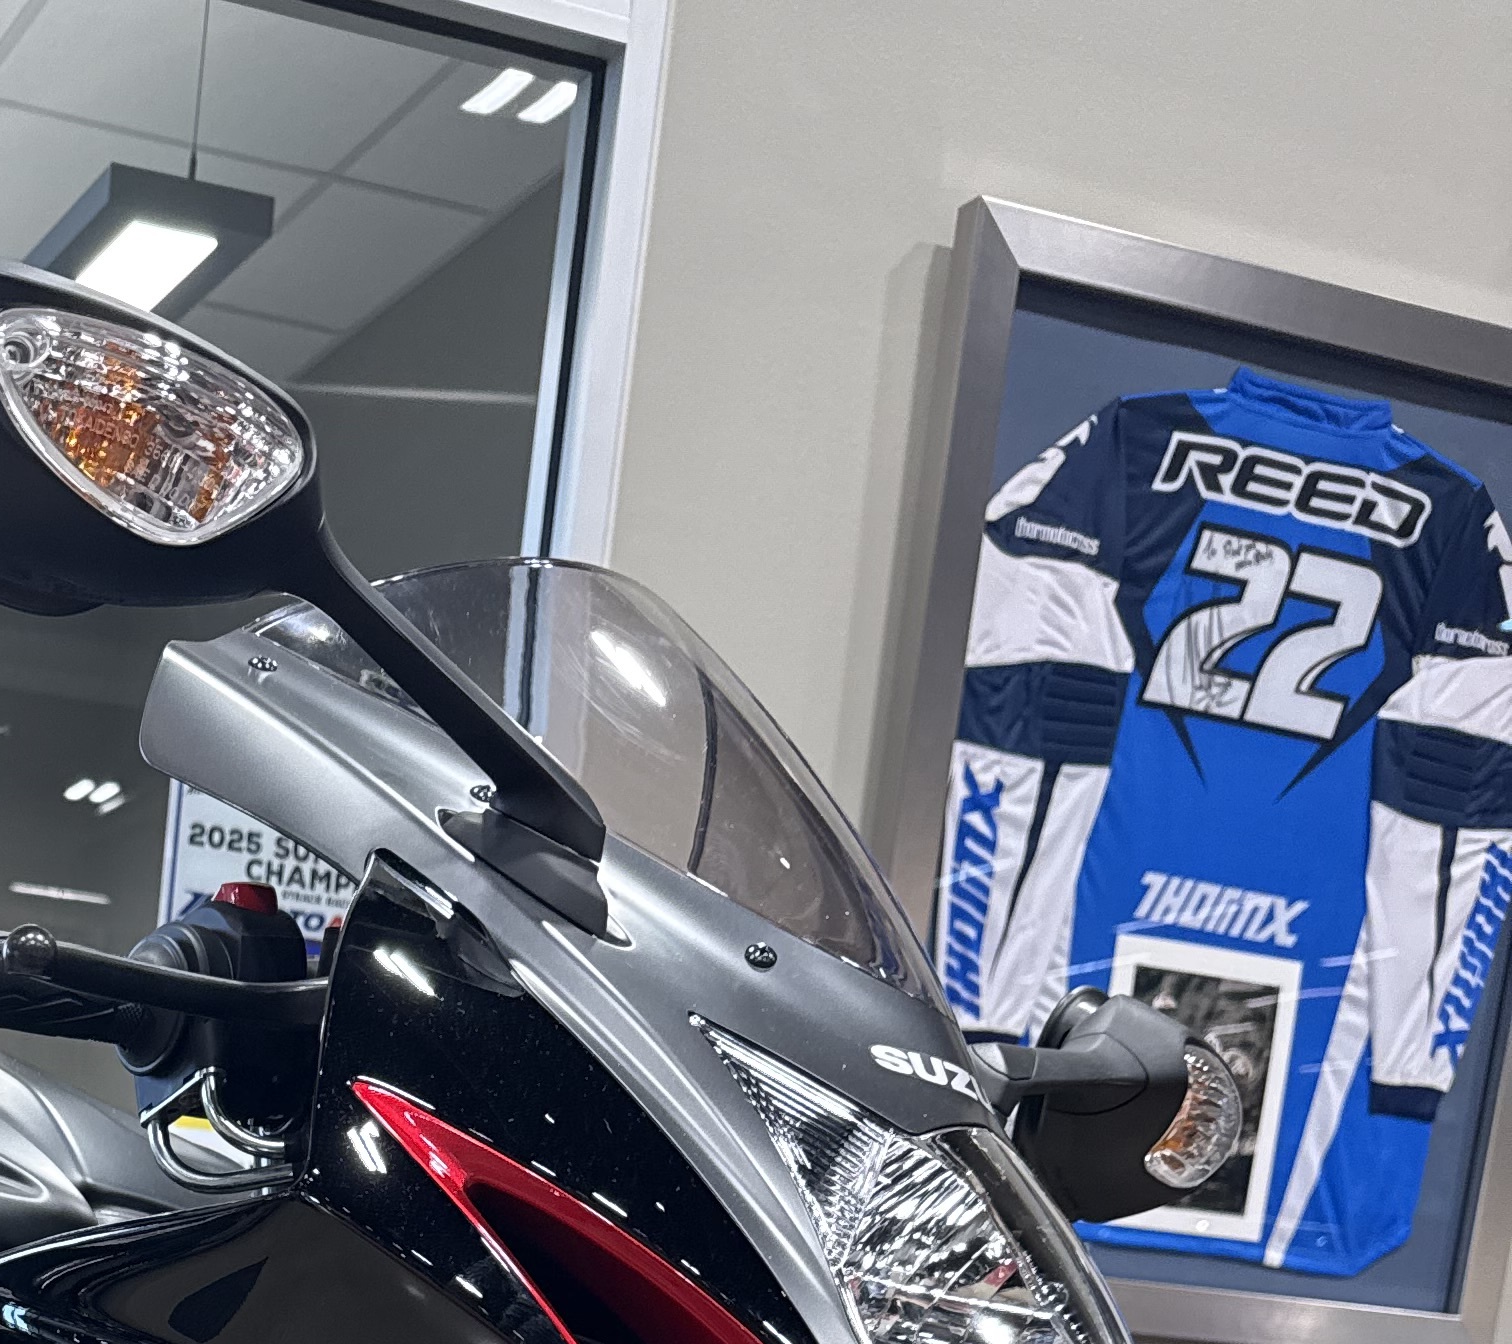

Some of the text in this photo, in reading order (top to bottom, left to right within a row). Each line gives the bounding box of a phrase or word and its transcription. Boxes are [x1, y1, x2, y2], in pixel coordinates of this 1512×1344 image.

[1152, 431, 1431, 547] REED
[1140, 523, 1384, 741] 22
[189, 823, 319, 864] 2025 SU
[870, 1044, 978, 1101] SUZ
